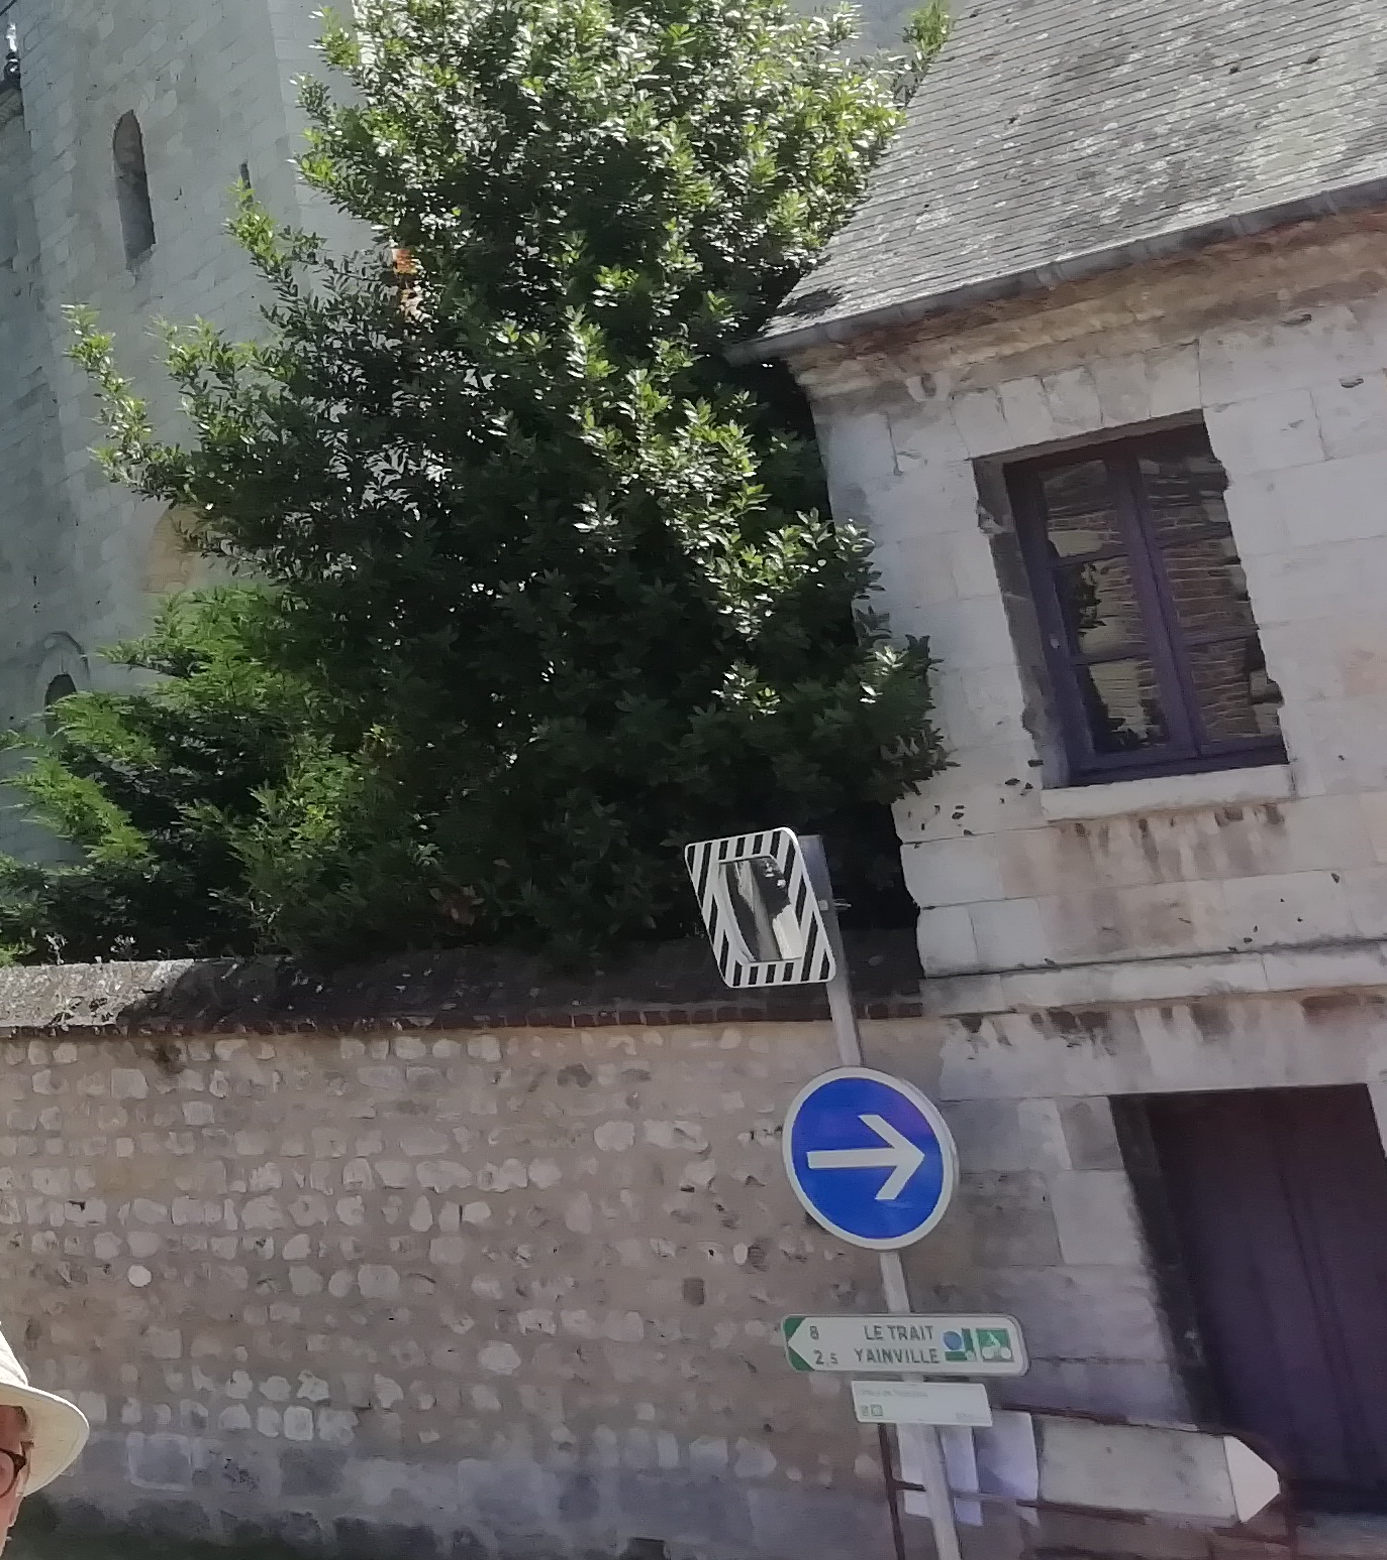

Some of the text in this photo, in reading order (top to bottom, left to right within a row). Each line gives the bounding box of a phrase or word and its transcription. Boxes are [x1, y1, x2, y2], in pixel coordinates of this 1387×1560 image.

[863, 1325, 883, 1341] LE
[886, 1325, 934, 1341] TRAIT
[854, 1348, 941, 1365] YAINVILLE
